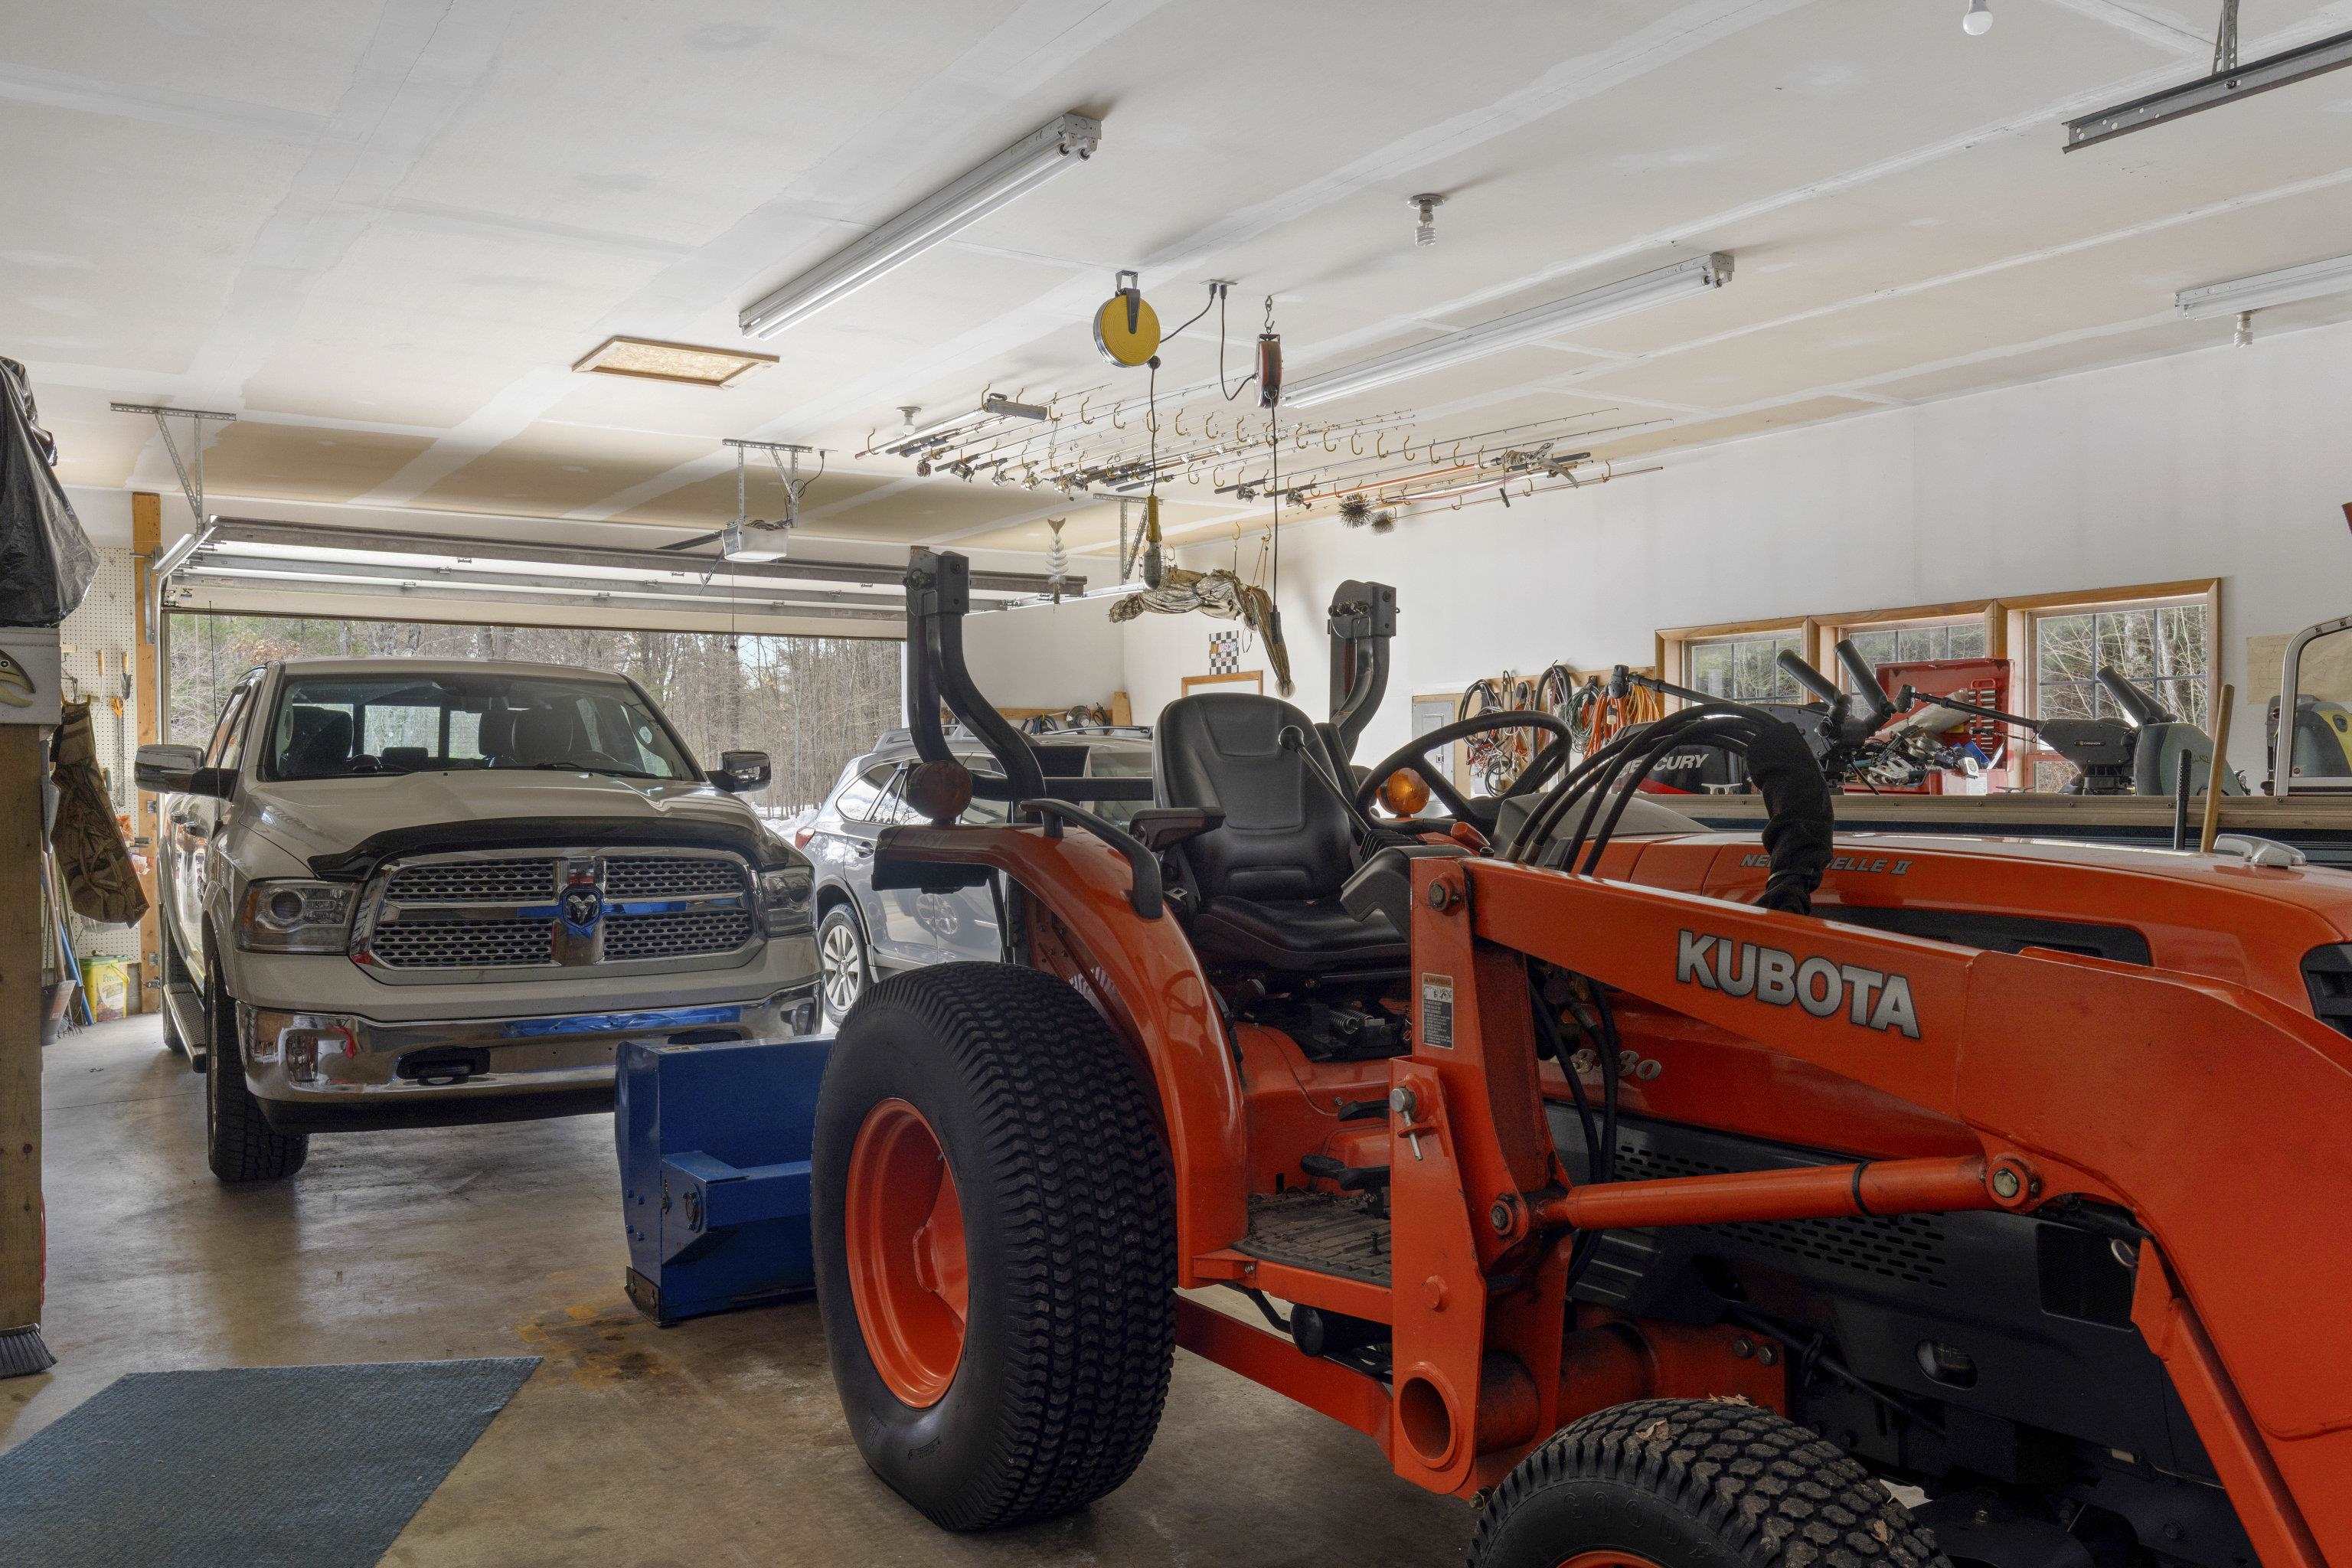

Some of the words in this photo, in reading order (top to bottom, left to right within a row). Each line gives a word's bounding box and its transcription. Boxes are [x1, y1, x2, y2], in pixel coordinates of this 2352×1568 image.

[1621, 753, 1709, 772] ECURY
[1677, 929, 1919, 1039] KUBOTA
[1573, 1047, 1662, 1081] 330
